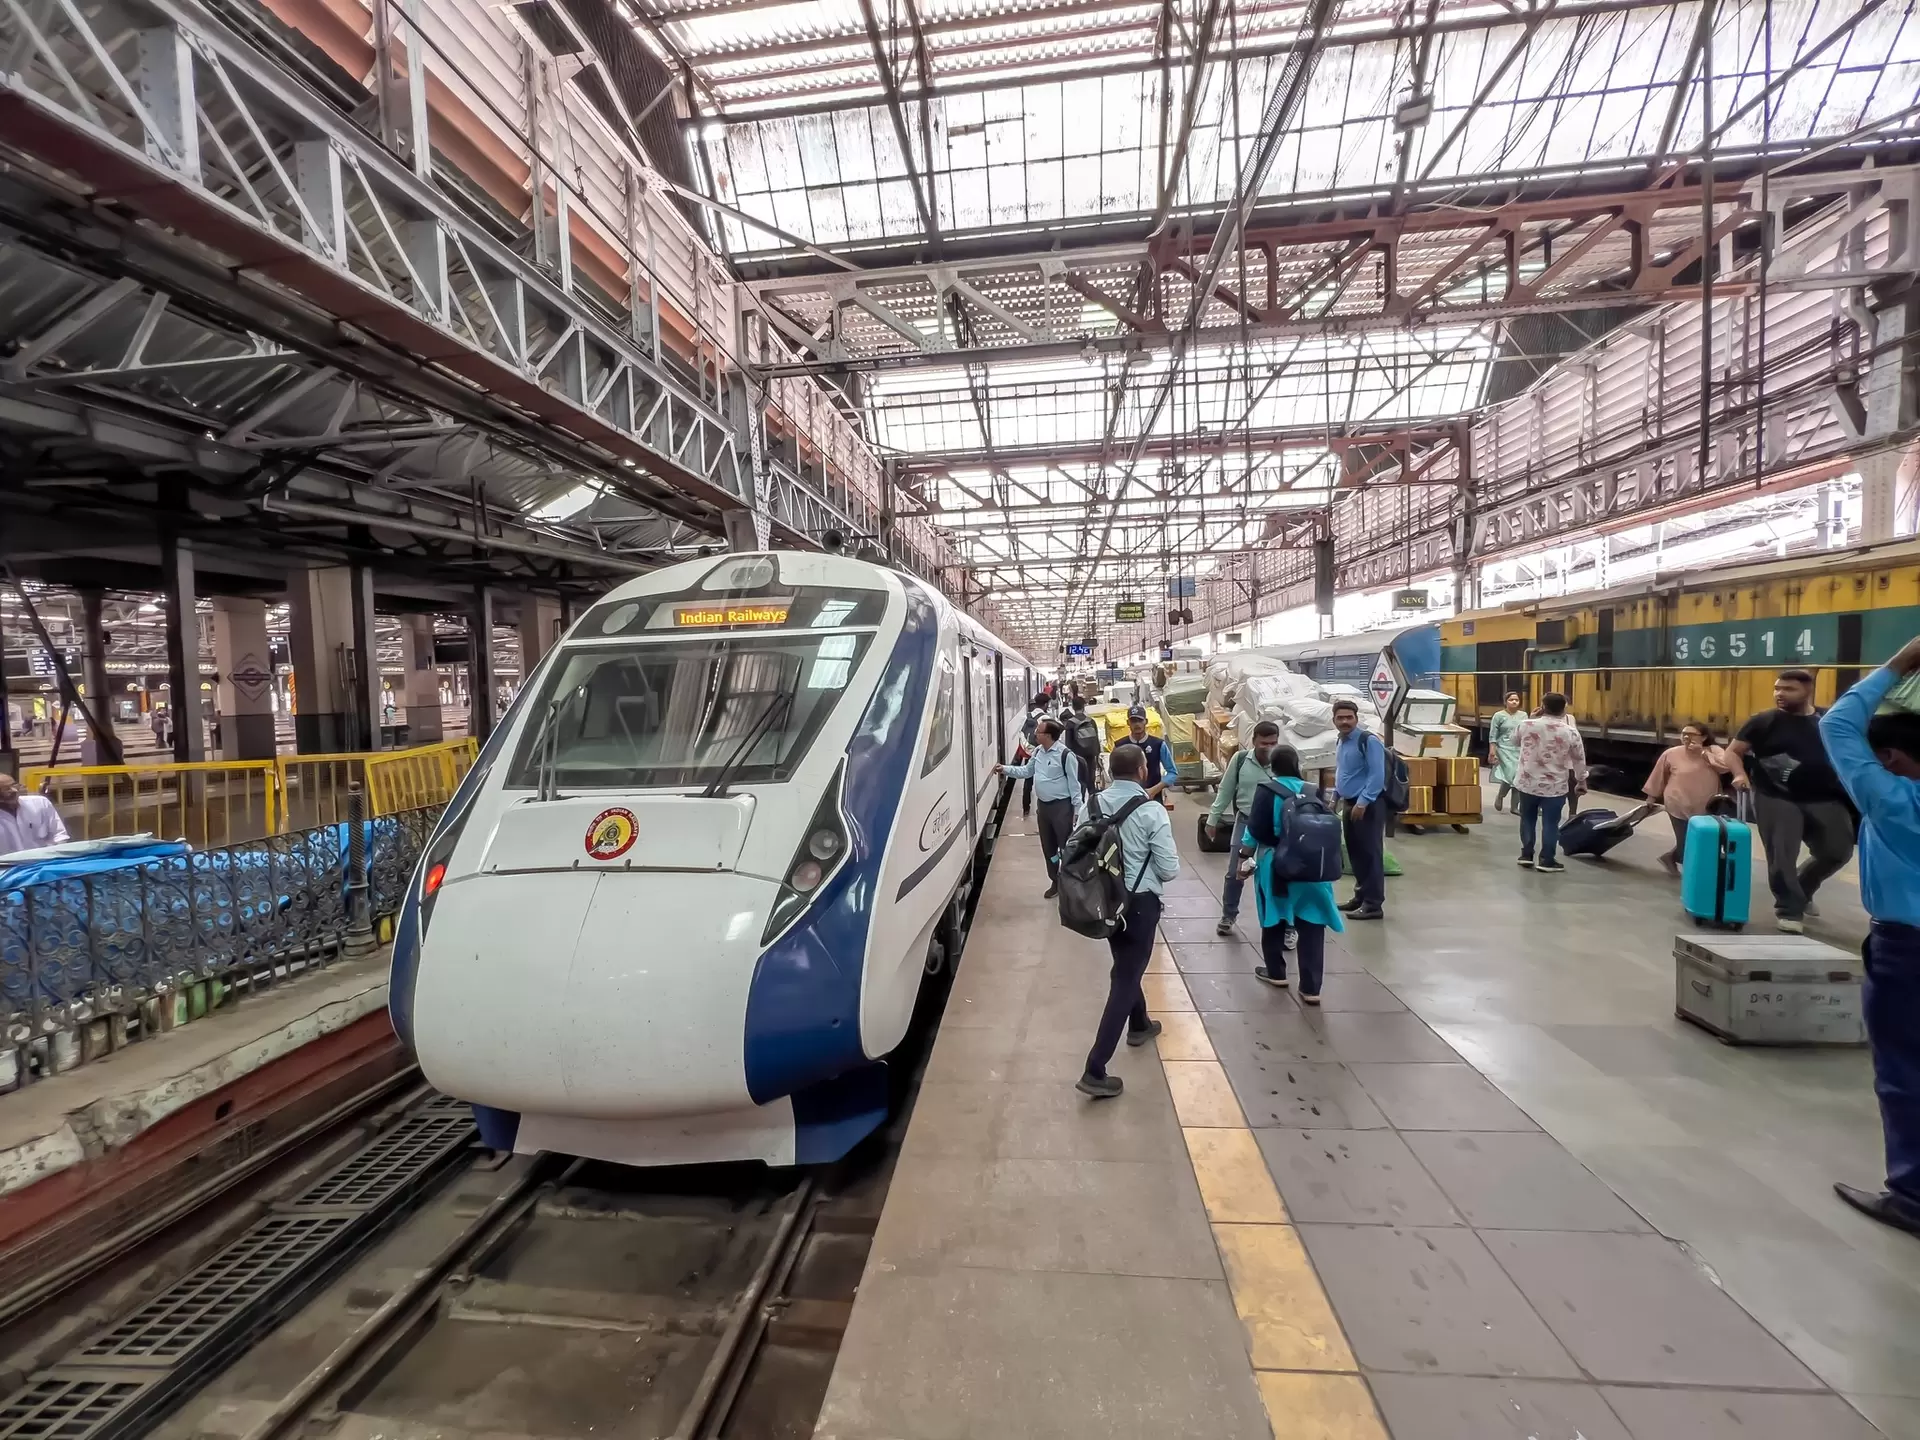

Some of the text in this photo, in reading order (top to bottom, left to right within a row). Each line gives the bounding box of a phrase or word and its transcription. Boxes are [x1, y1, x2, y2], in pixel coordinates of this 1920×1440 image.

[680, 609, 787, 624] Indian Railways
[1675, 629, 1814, 660] 36514
